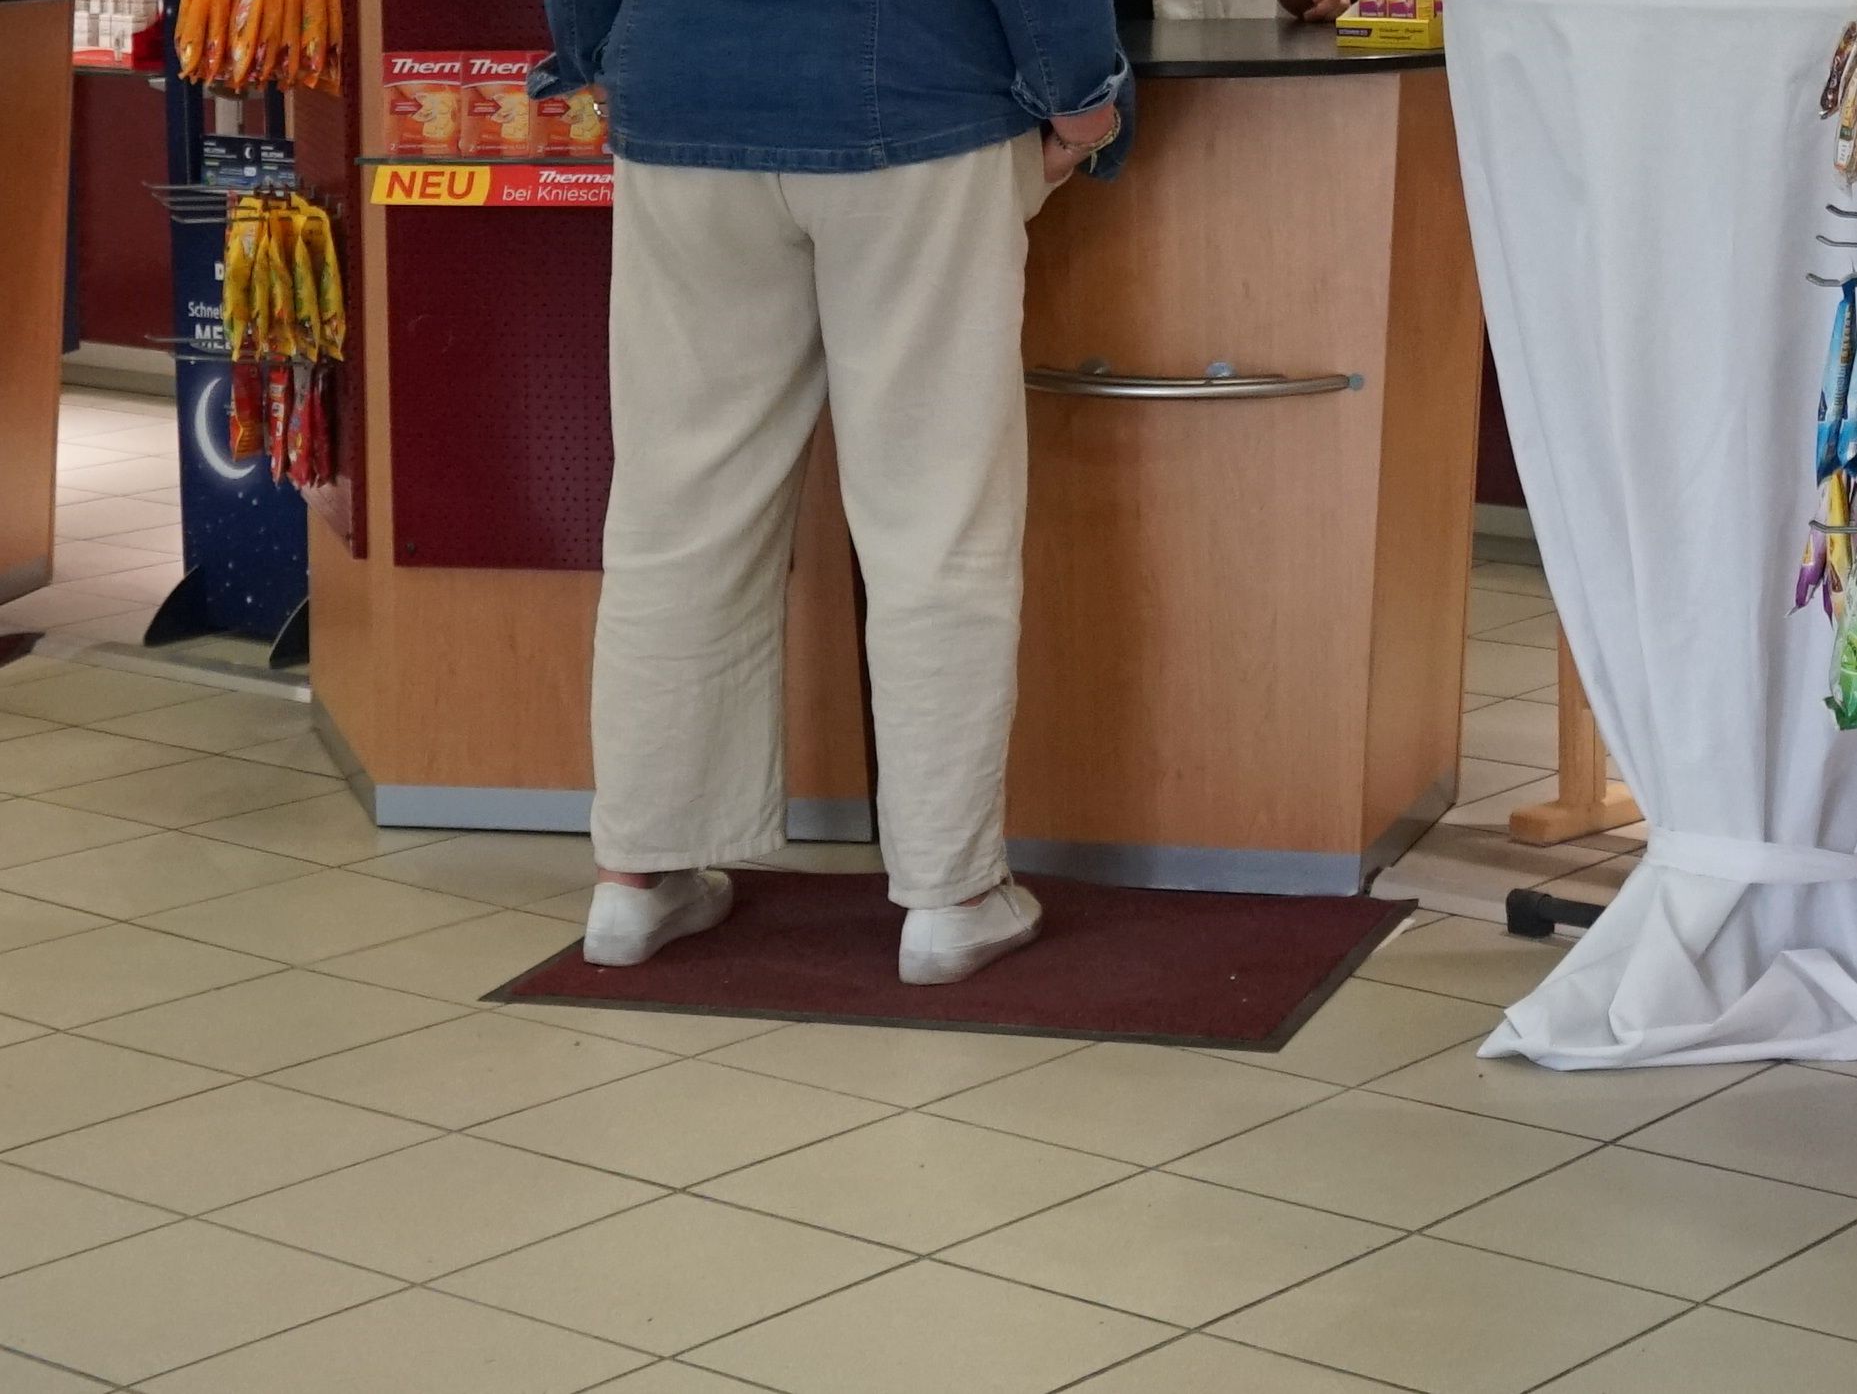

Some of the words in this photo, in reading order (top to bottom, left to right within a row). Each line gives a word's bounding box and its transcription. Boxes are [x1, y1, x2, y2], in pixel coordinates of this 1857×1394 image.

[385, 170, 477, 200] NEU
[538, 170, 614, 184] Therma
[502, 185, 532, 201] bei
[537, 185, 614, 202] Kniesch
